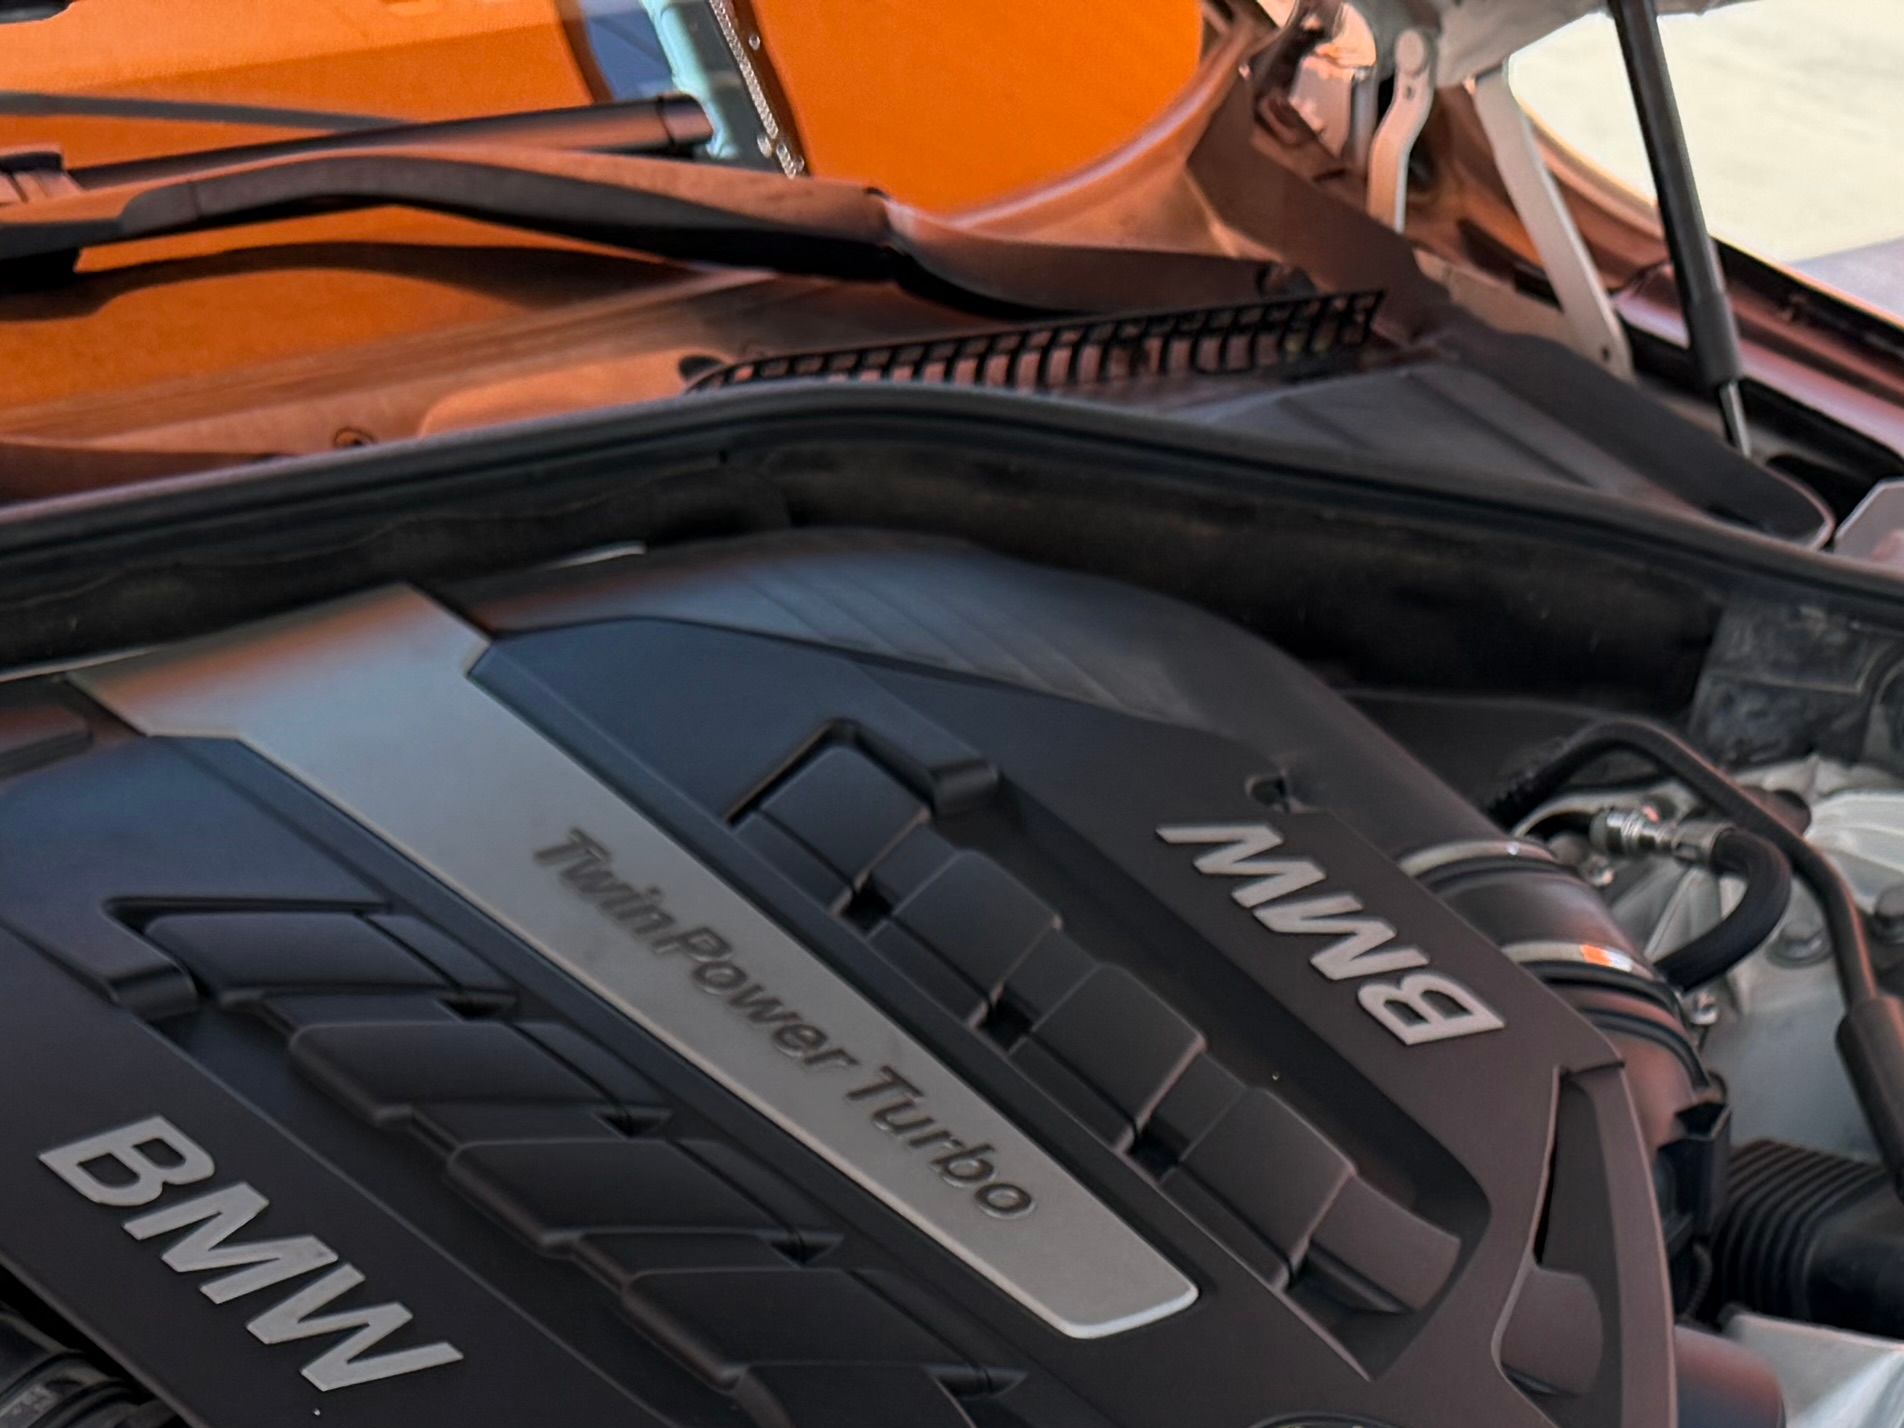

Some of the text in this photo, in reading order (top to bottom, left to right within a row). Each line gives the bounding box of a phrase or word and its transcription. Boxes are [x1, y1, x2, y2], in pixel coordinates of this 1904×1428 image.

[532, 827, 1037, 1220] TwinPower Turbo
[1156, 823, 1507, 1047] BMW
[37, 1114, 464, 1392] BMW
